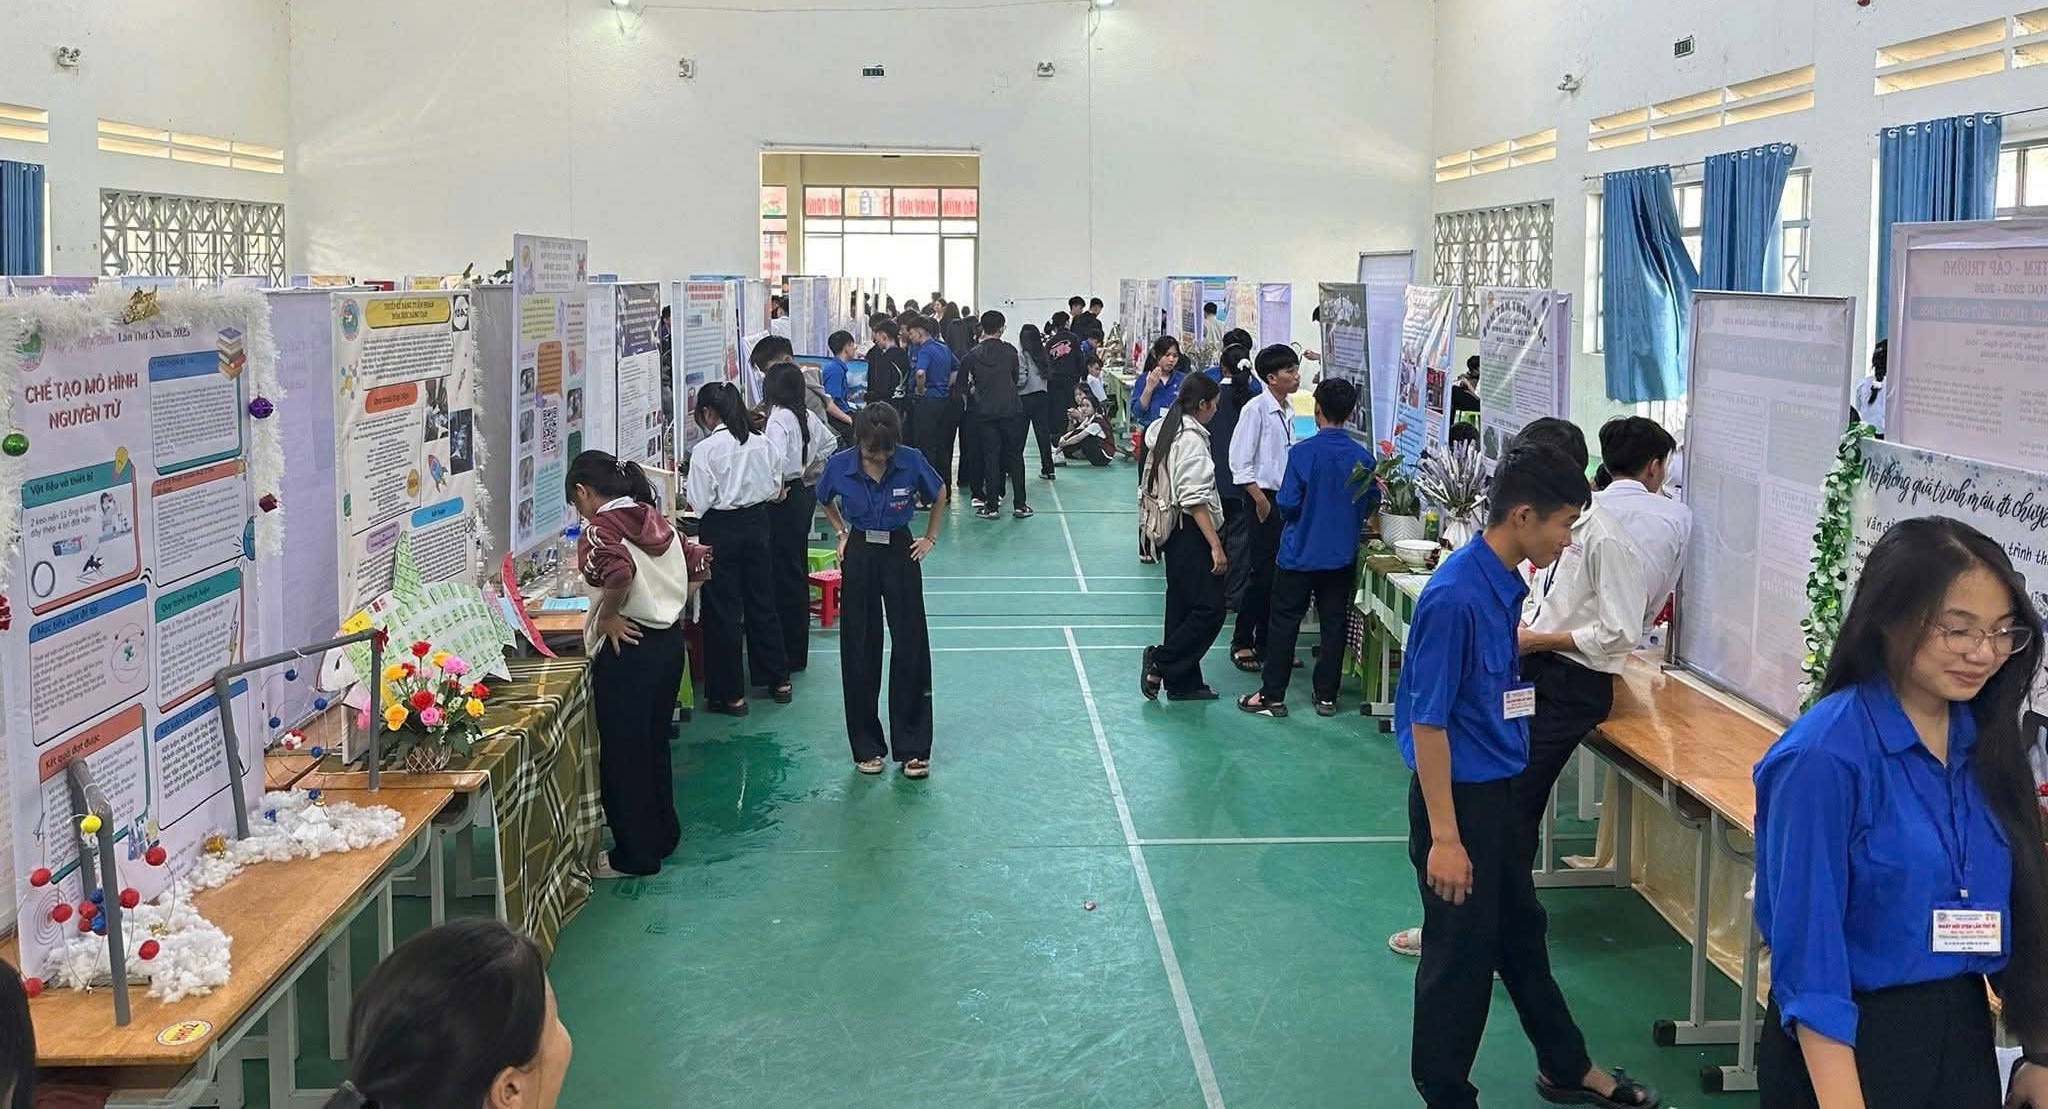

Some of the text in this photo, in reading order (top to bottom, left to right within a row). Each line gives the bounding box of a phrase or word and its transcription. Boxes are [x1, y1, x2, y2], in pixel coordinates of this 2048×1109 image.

[25, 369, 138, 404] CHẾ TẠO MÔ HÌNH
[49, 404, 100, 430] NGUYÊN
[1875, 461, 1912, 503] phỏng
[1912, 477, 1934, 505] quá
[1933, 478, 1972, 508] trình
[1967, 491, 1996, 512] máu
[2009, 542, 2032, 561] trình
